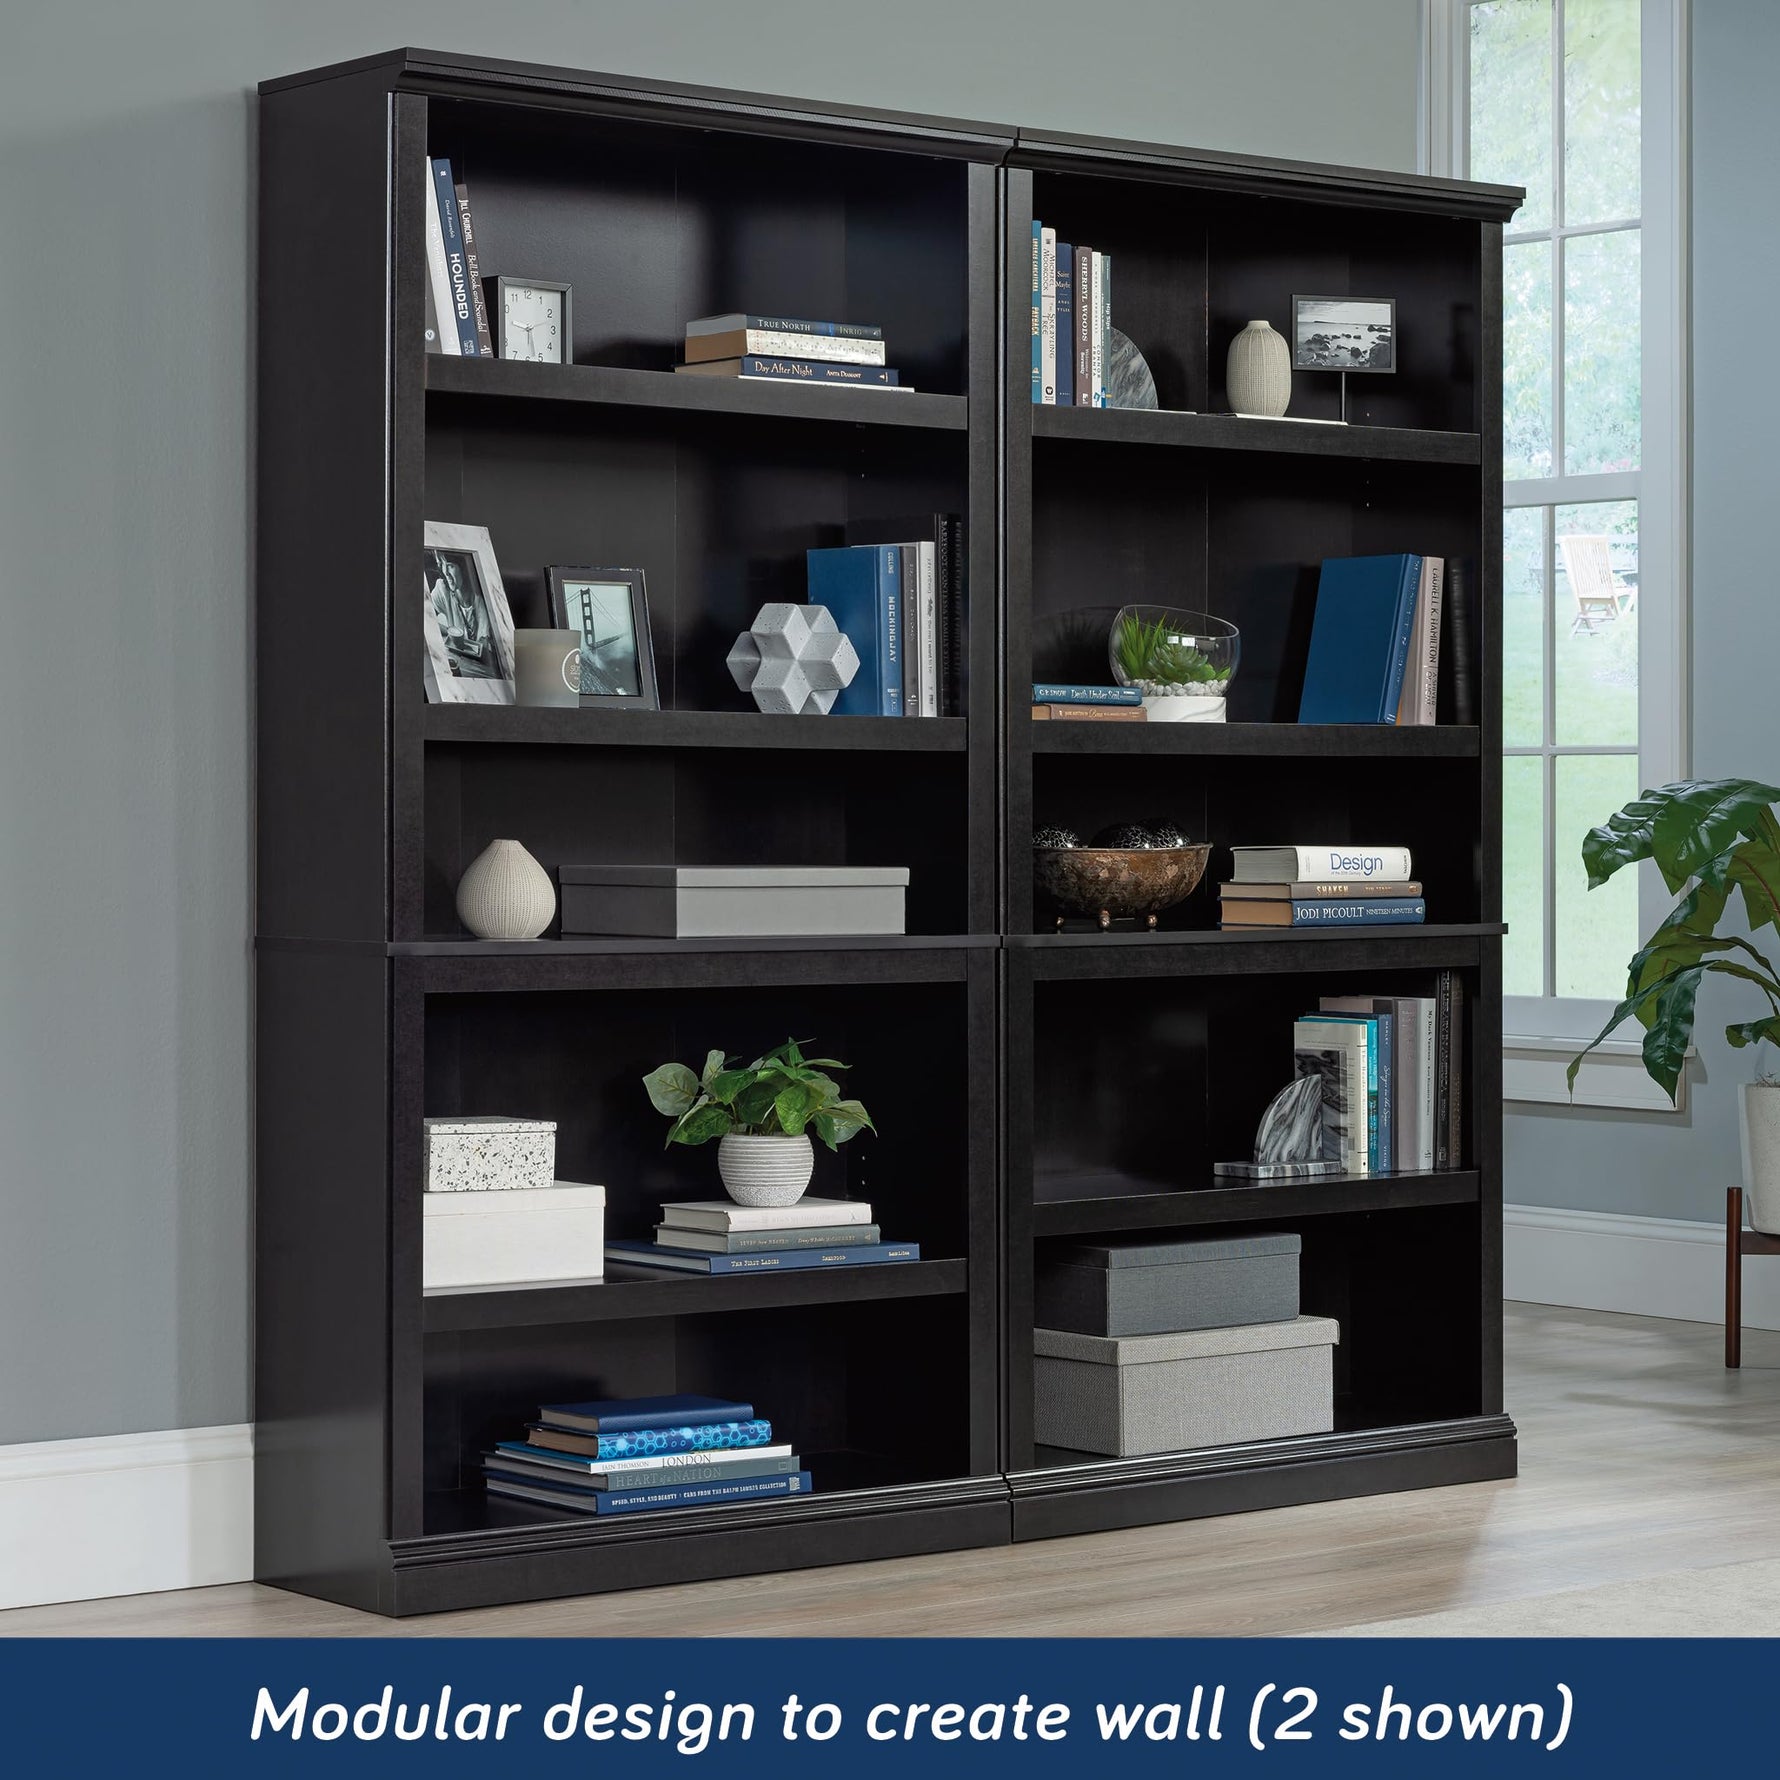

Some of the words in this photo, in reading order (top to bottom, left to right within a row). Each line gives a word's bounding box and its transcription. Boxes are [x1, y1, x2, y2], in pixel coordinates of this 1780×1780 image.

[458, 200, 469, 211] JILL
[462, 212, 473, 244] CHURCHILL
[1042, 248, 1050, 291] MOORCOCK
[1057, 270, 1070, 278] Saint
[450, 253, 469, 320] HOUNDED
[1056, 280, 1071, 290] Maybe
[511, 294, 518, 302] 11
[524, 290, 532, 300] 12
[539, 296, 543, 304] 1
[475, 303, 488, 333] Scandal
[547, 308, 553, 318] 2
[757, 319, 780, 329] TRUE
[781, 320, 811, 332] NORTH
[1032, 306, 1040, 336] PAYBACK
[1042, 313, 1050, 335] TREE
[550, 325, 556, 336] 3
[546, 342, 552, 351] 4
[512, 350, 518, 360] 7
[538, 352, 544, 362] 5
[754, 361, 770, 374] Day
[770, 362, 791, 374] After
[792, 364, 813, 377] Night
[1432, 568, 1440, 605] LAURELL
[1430, 608, 1439, 616] K.
[888, 596, 896, 662] MOCKINGJAY
[1429, 618, 1440, 664] HAMILTON
[1089, 690, 1108, 699] Under
[1424, 684, 1432, 706] LIGHT
[1330, 852, 1383, 876] Design
[1296, 907, 1319, 920] JODI
[1322, 906, 1365, 918] PICOULT
[1427, 1010, 1432, 1019] My
[602, 1463, 616, 1471] IAIN
[617, 1460, 649, 1470] THOMSON
[662, 1454, 712, 1468] LONDON
[616, 1474, 658, 1487] HEART
[673, 1467, 722, 1482] NATION
[712, 1488, 722, 1496] THE
[740, 1485, 759, 1493] LAUREN
[759, 1482, 787, 1491] COLLECTION
[612, 1499, 629, 1507] SPEED,
[630, 1497, 646, 1506] STYLE,
[658, 1493, 677, 1502] BEAUTY
